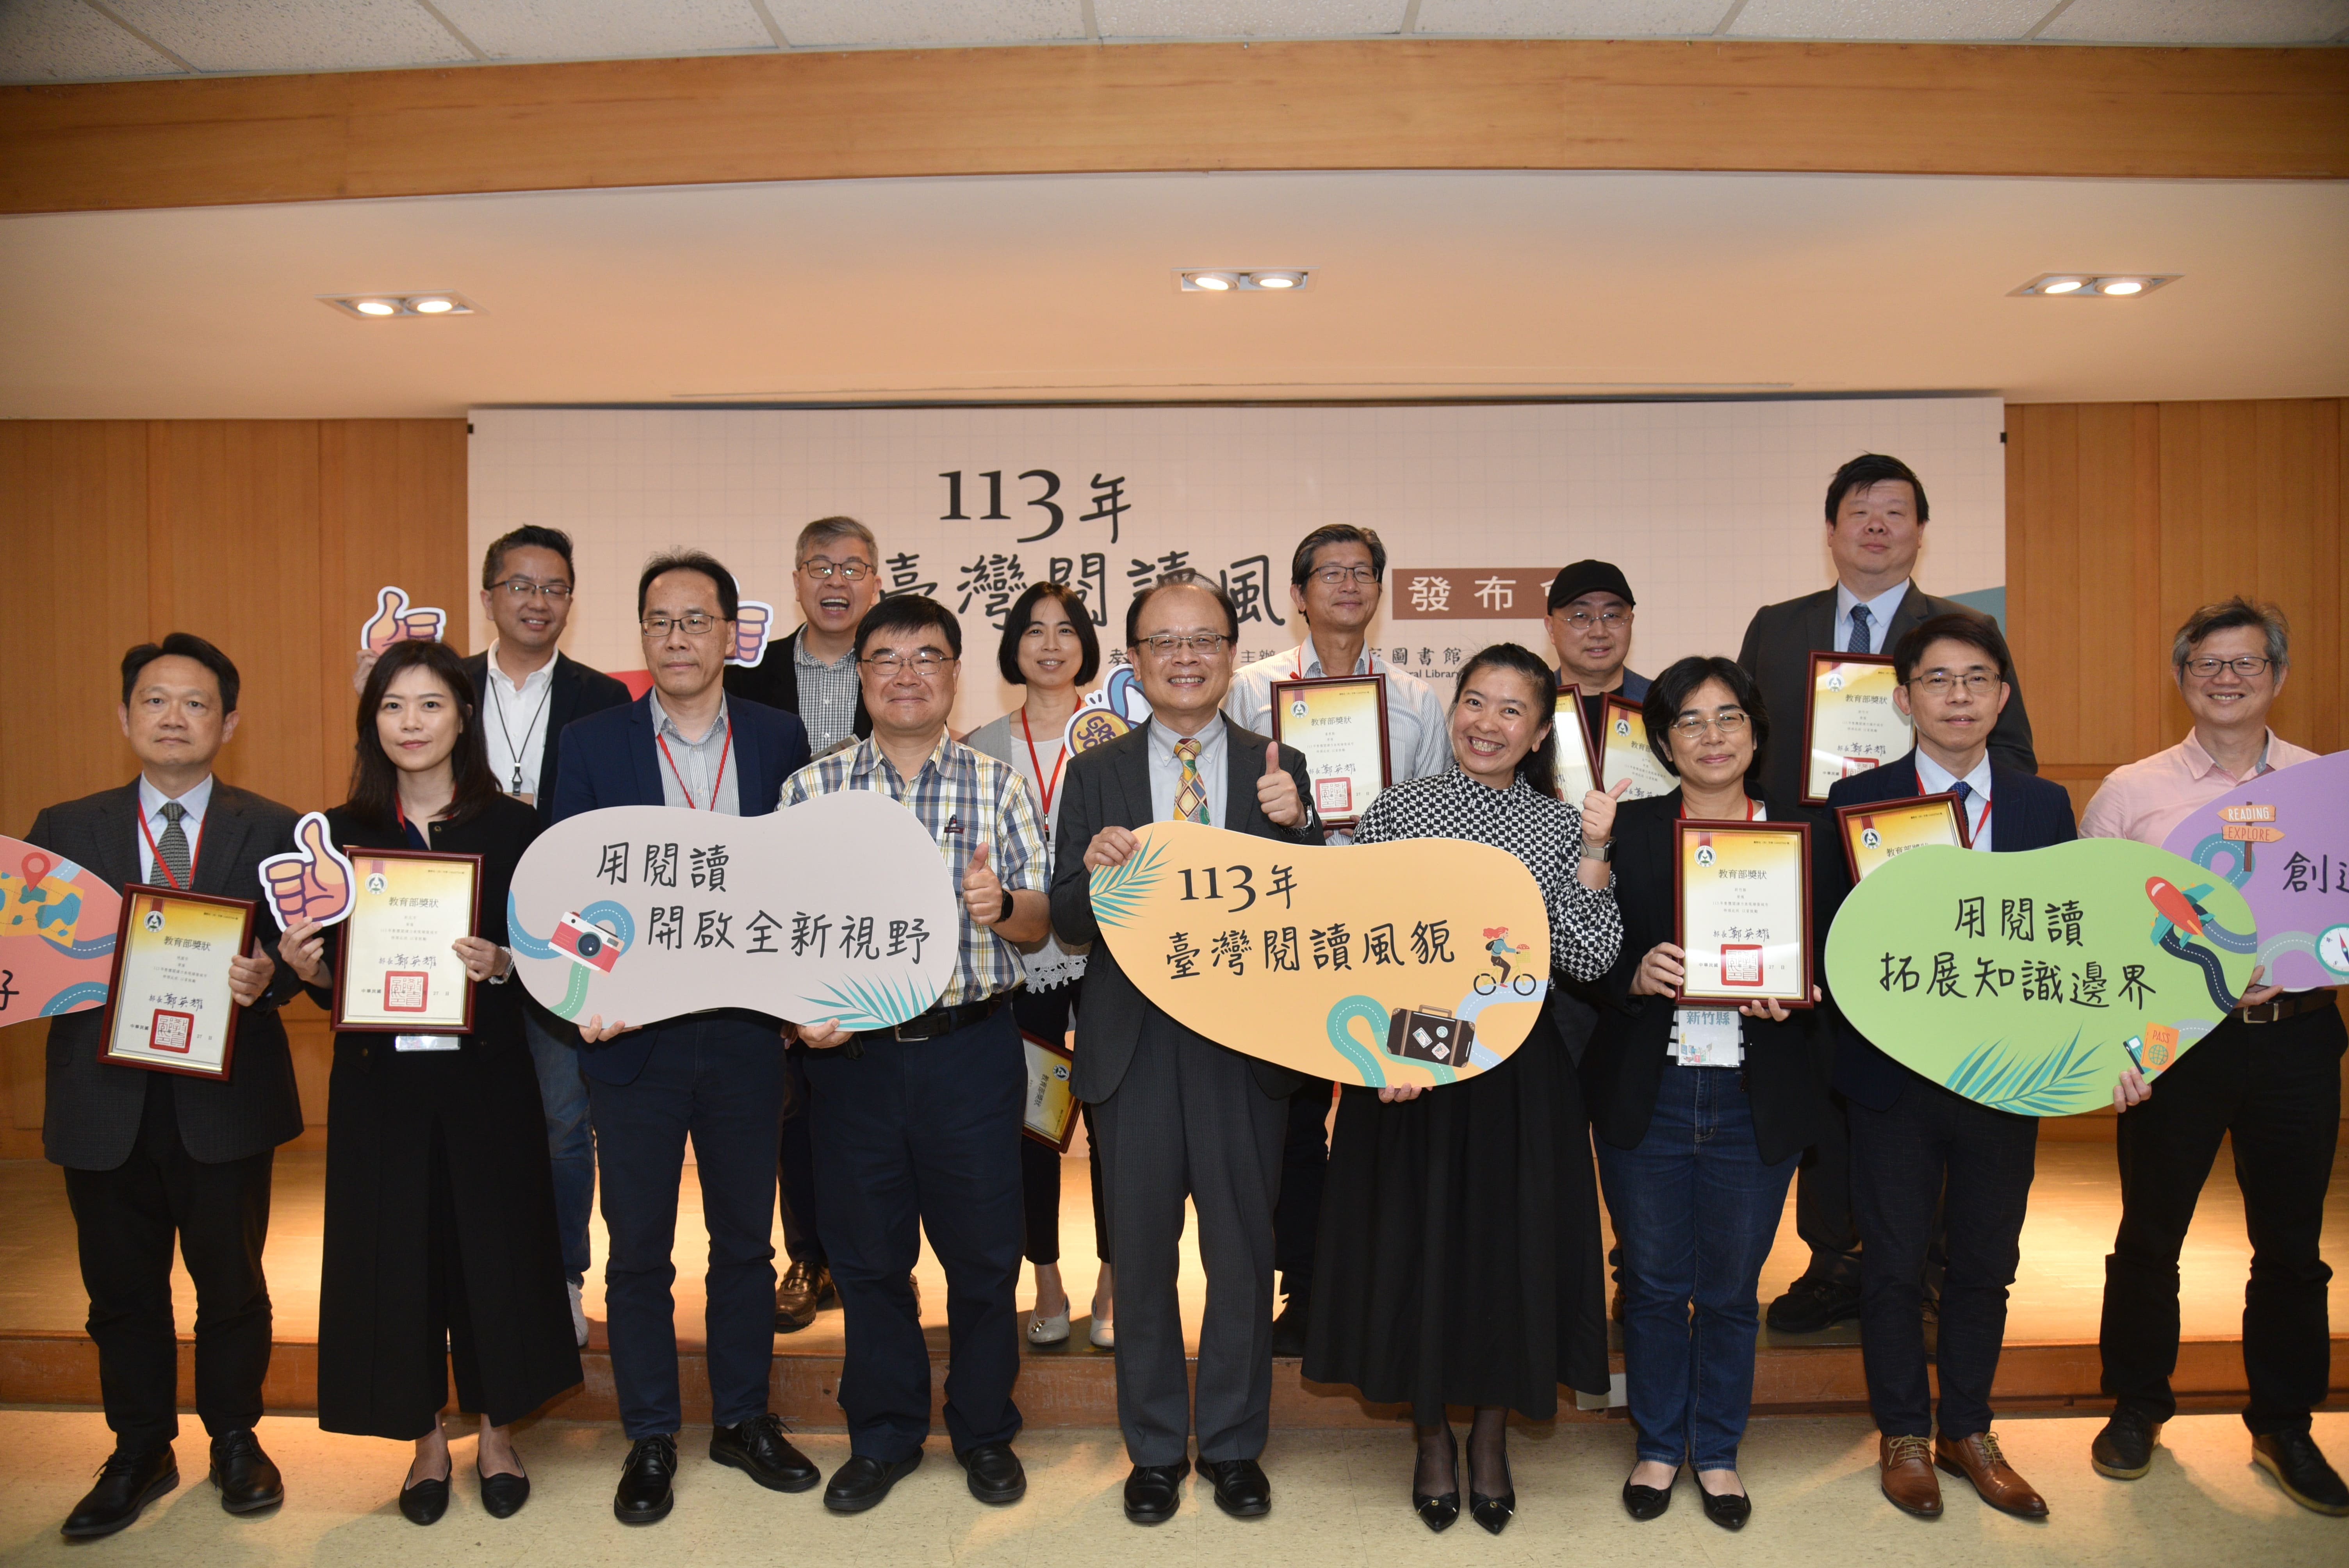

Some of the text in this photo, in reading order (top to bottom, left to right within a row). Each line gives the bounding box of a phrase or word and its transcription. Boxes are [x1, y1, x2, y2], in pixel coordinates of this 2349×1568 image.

[939, 469, 1132, 544] 113年
[1845, 694, 1887, 705] 教育部獎狀
[1311, 716, 1352, 726] 教育部獎狀
[2228, 807, 2269, 821] READING
[2228, 827, 2270, 841] EXPLORE
[597, 841, 729, 892] 用閱讀
[1718, 869, 1767, 880] 教育部獎狀
[1177, 864, 1297, 912] 113年
[389, 896, 439, 909] 教育部獎狀
[1954, 896, 2084, 947] 用閱讀
[648, 905, 930, 964] 開啟全新視野
[164, 935, 211, 952] 教育部獎狀
[1166, 919, 1455, 980] 臺灣閱讀風貌
[1879, 951, 2156, 1010] 拓展知識邊界
[1686, 1011, 1730, 1025] 新竹縣
[2152, 1030, 2170, 1043] PASS
